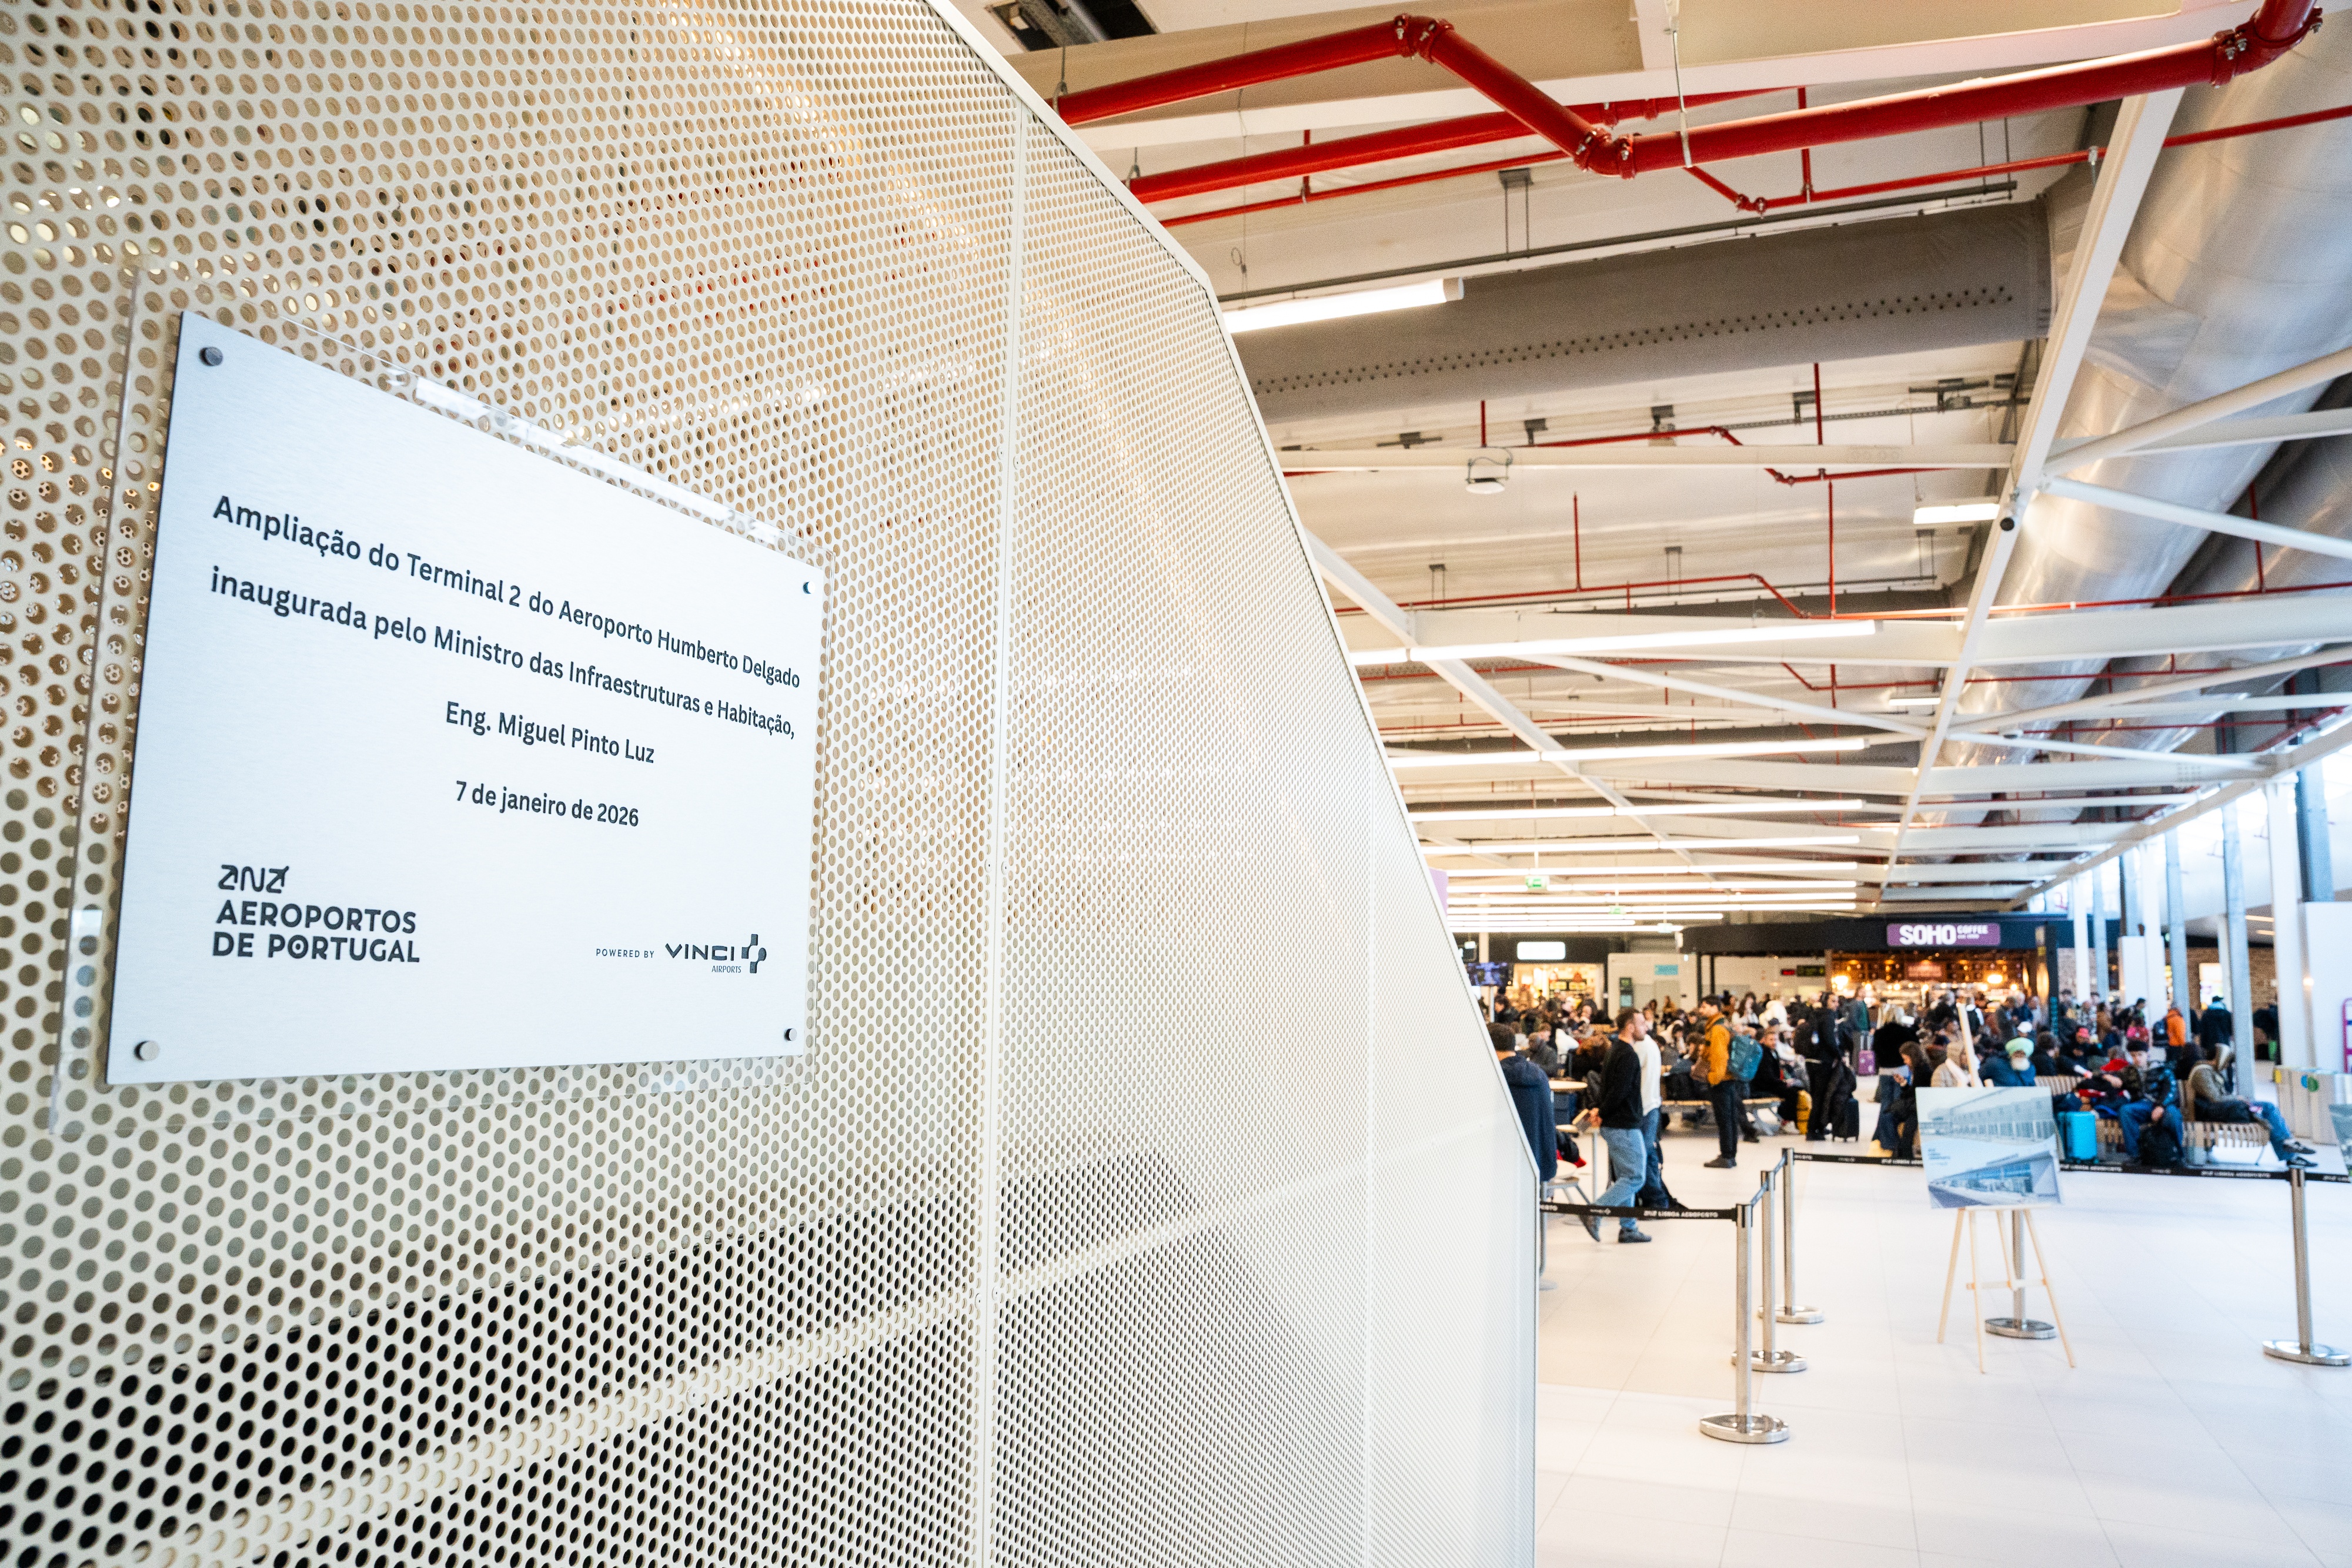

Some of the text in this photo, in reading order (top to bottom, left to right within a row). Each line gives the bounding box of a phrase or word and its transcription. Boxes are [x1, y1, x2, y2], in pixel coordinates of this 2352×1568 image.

[212, 495, 800, 688] Ampliação do Terminal 2 do Aeroporto Humberto Delgado
[211, 565, 794, 740] inaugurada pelo Ministro das Infraestruturas e Habitação,
[446, 701, 654, 764] Eng. Miguel Pinto Luz
[456, 780, 639, 827] 7 de janeiro de 2026
[215, 899, 416, 934] AEROPORTOS
[212, 931, 420, 963] DE PORTUGAL
[1899, 925, 1956, 945] SOHO
[596, 948, 654, 958] POWERED BY
[664, 943, 735, 961] VINCI
[711, 965, 741, 974] AIRPORTS
